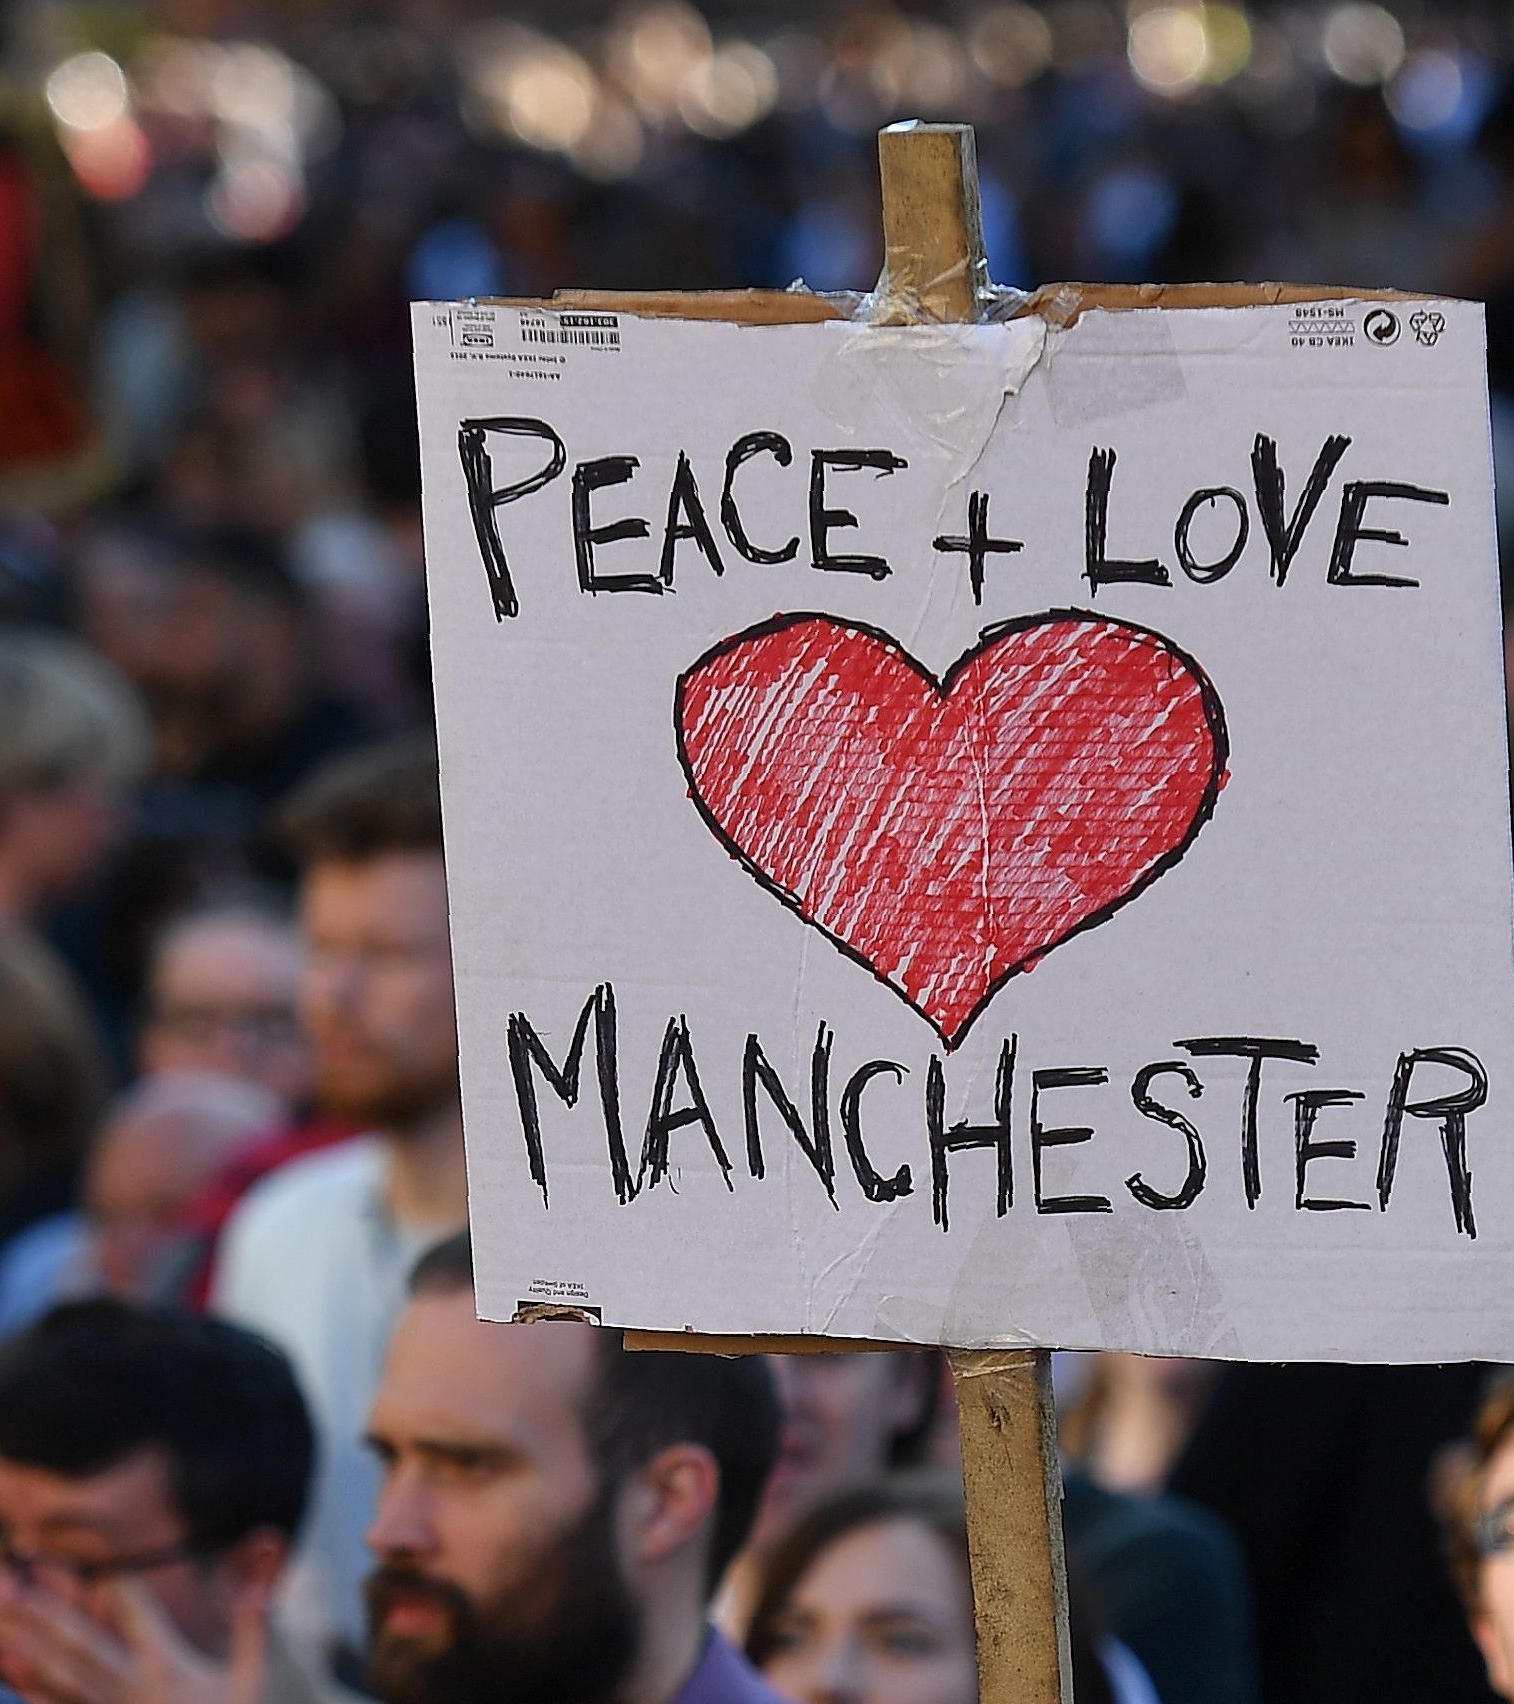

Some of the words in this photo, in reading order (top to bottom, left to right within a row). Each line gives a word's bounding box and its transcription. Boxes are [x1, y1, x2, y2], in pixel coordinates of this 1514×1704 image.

[1291, 336, 1306, 346] 40
[1308, 336, 1324, 347] CB
[1326, 336, 1354, 347] IKEA
[458, 417, 908, 620] PEACE
[933, 491, 1024, 605] +
[1081, 433, 1449, 598] LOVE
[507, 982, 1489, 1239] MANCHESTER
